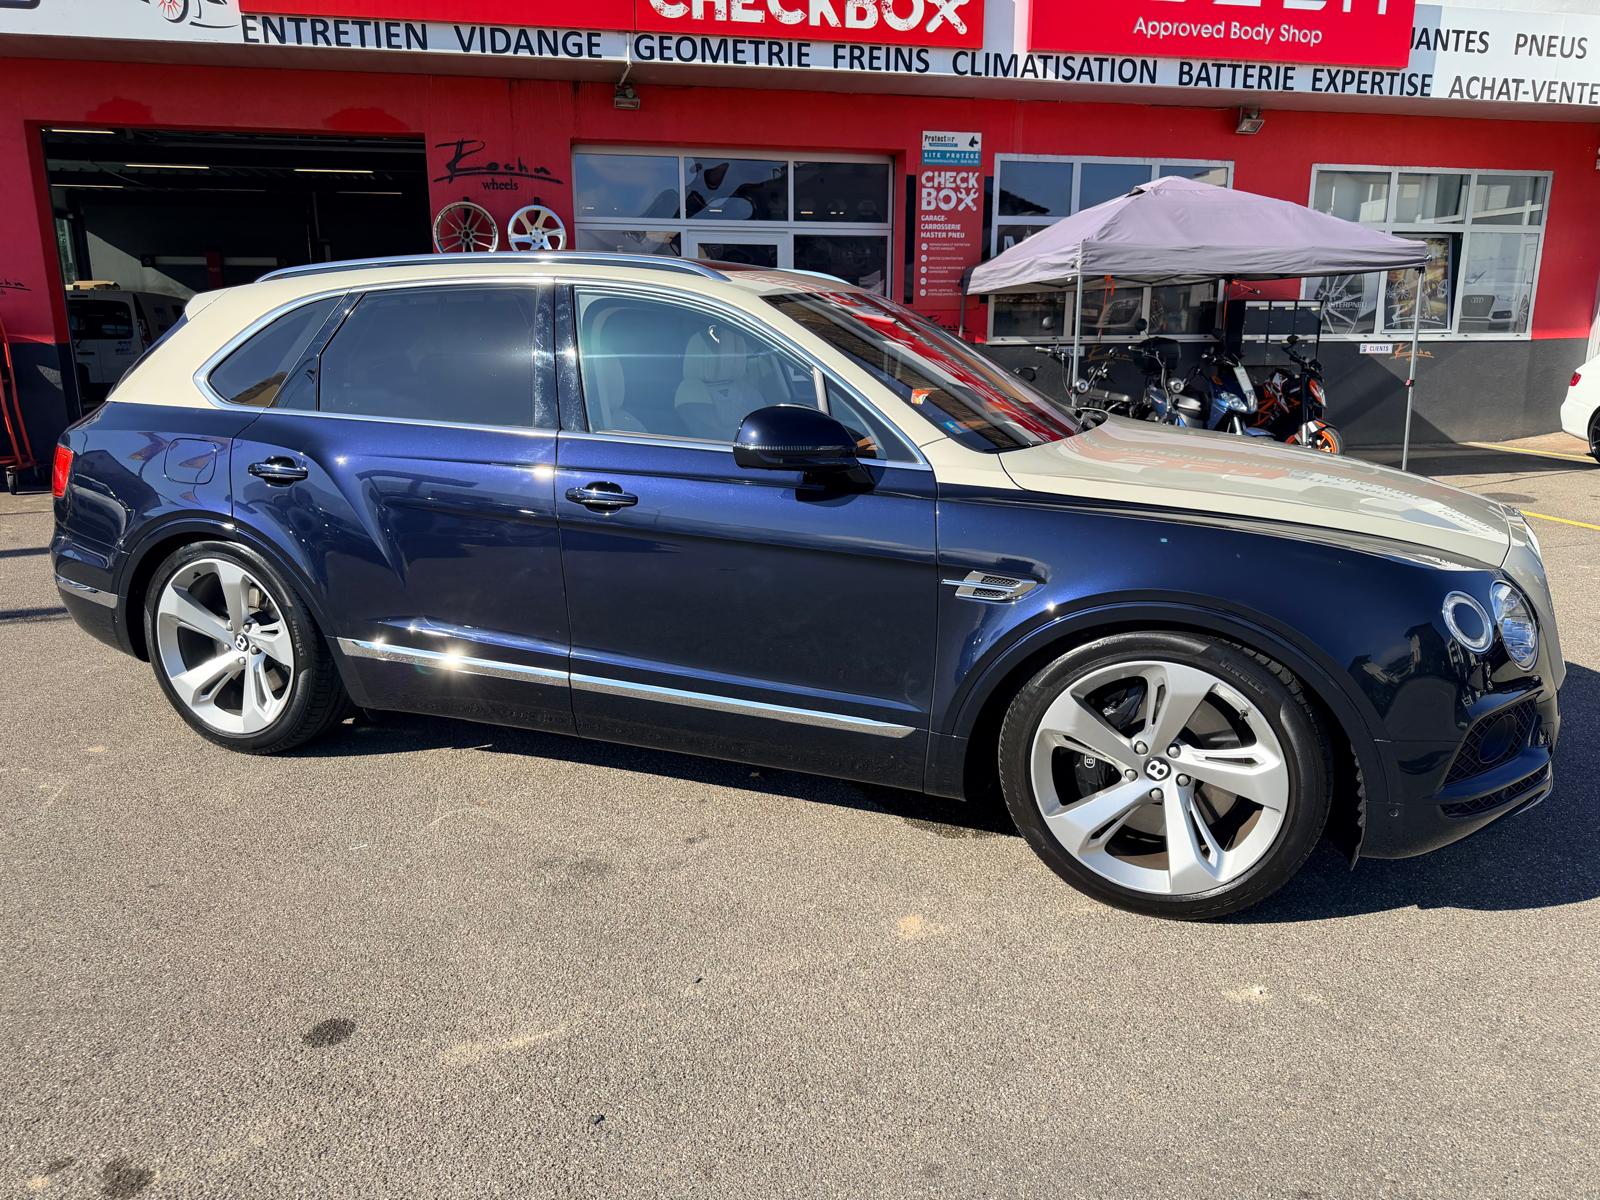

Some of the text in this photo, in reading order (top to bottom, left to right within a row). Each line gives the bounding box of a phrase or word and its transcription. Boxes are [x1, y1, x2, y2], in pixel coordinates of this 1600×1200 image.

[1133, 16, 1323, 45] Approved Body Shop
[1409, 27, 1588, 60] JANTES PNEUS
[241, 15, 1432, 97] ENTRETIEN VIDANGE GEOMETRIE FREINS CLIMATISATION BATTERIE EXPERTISE
[1448, 75, 1600, 105] ACHAT-VENTE
[482, 178, 518, 191] wheels
[921, 171, 979, 188] CHECK
[921, 187, 979, 211] BOX
